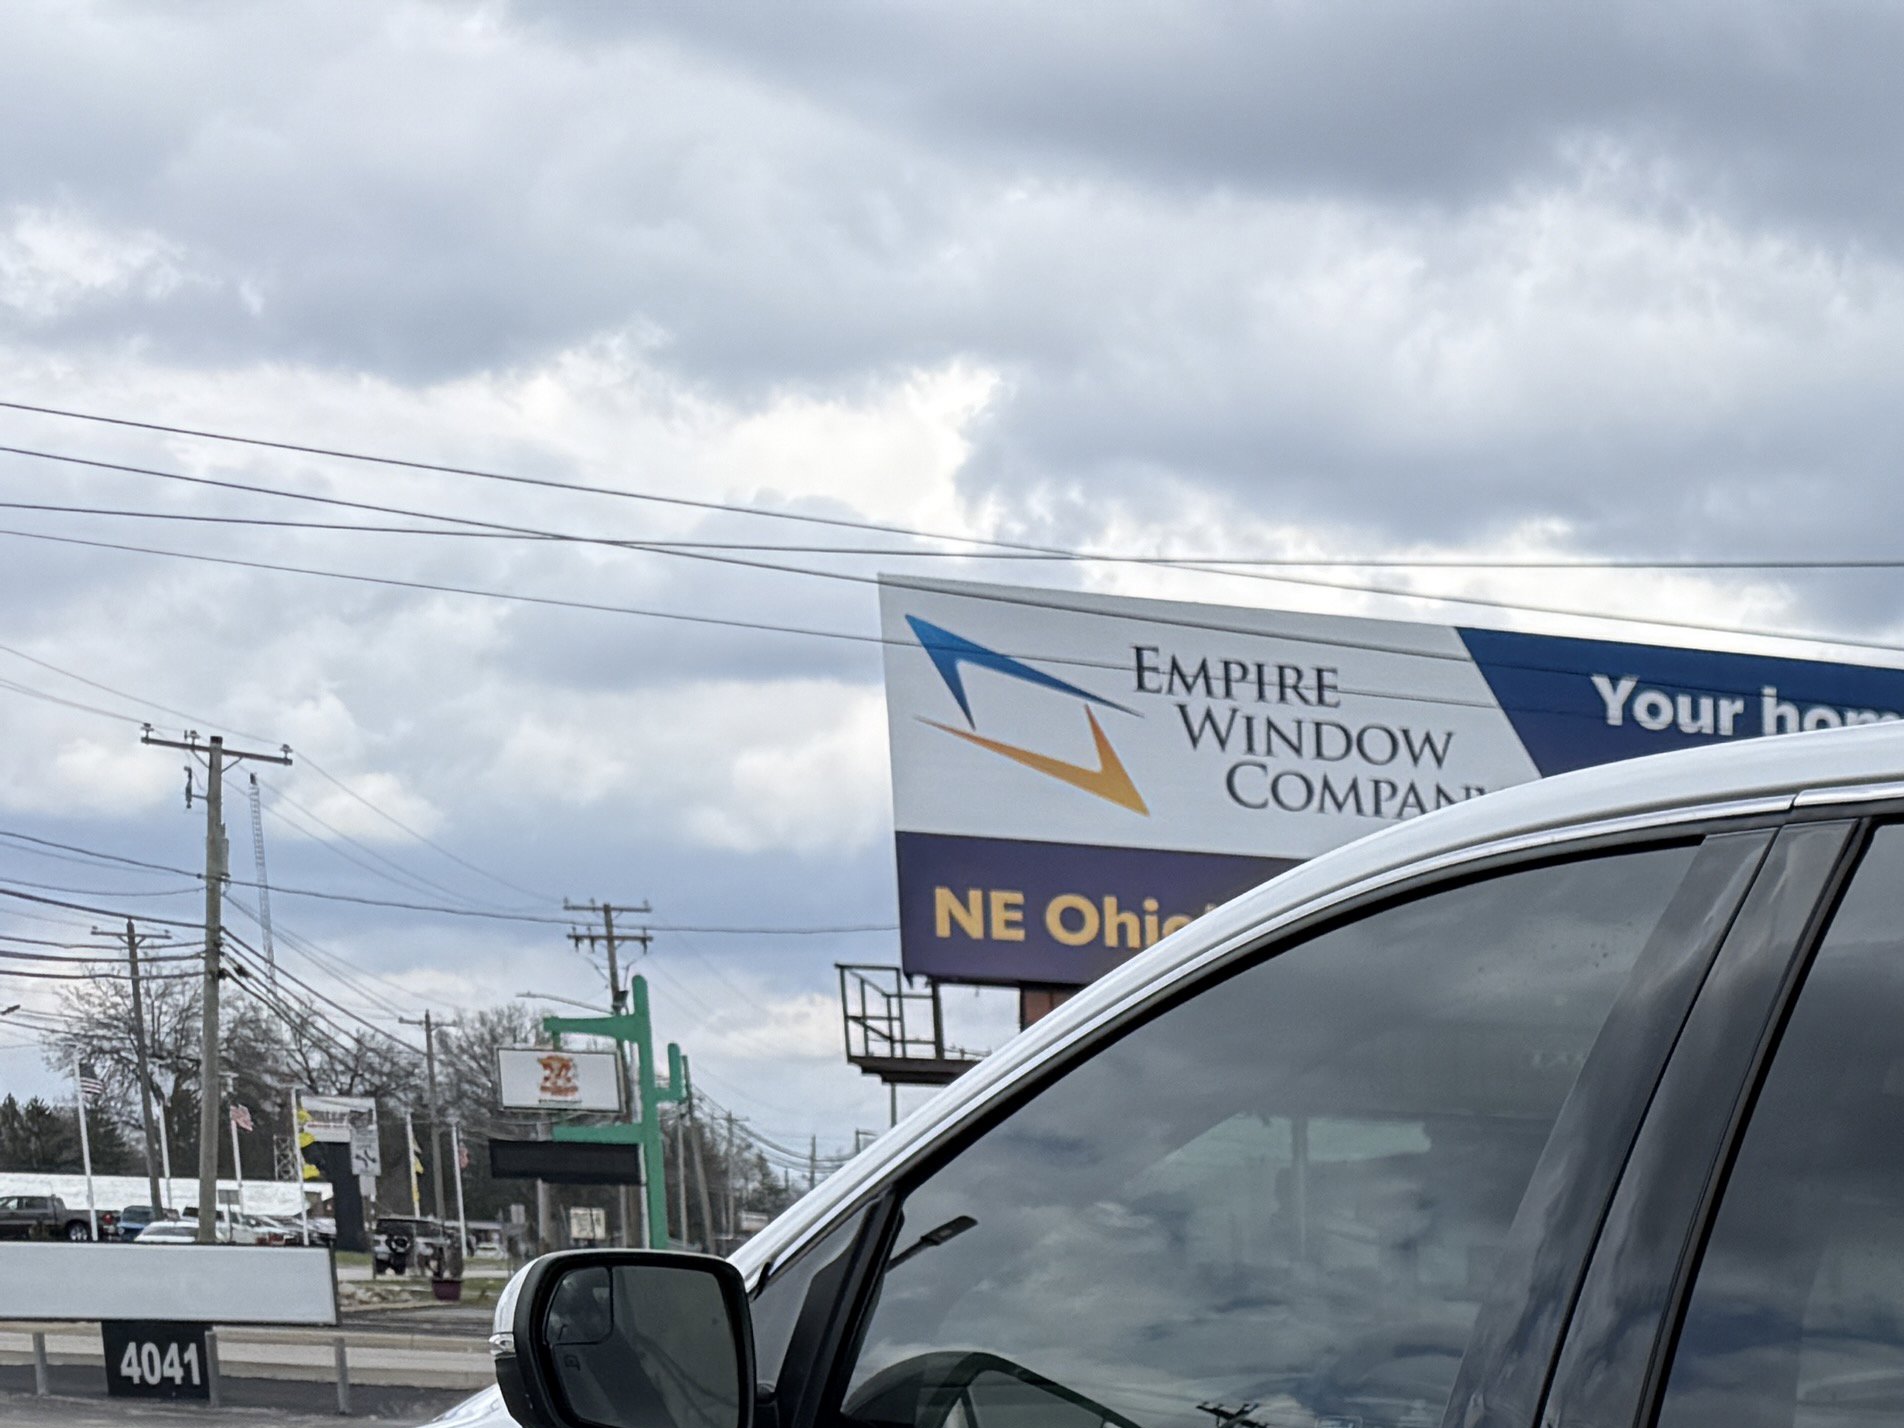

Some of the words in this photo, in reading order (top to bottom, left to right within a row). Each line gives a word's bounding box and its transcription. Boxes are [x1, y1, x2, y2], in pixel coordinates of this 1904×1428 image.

[1130, 645, 1342, 709] EMPIRE
[1590, 673, 1745, 736] Your
[1176, 703, 1455, 770] WINDOW
[1225, 760, 1487, 819] COMPAN
[934, 885, 1026, 942] NE
[120, 1341, 201, 1385] 4041
